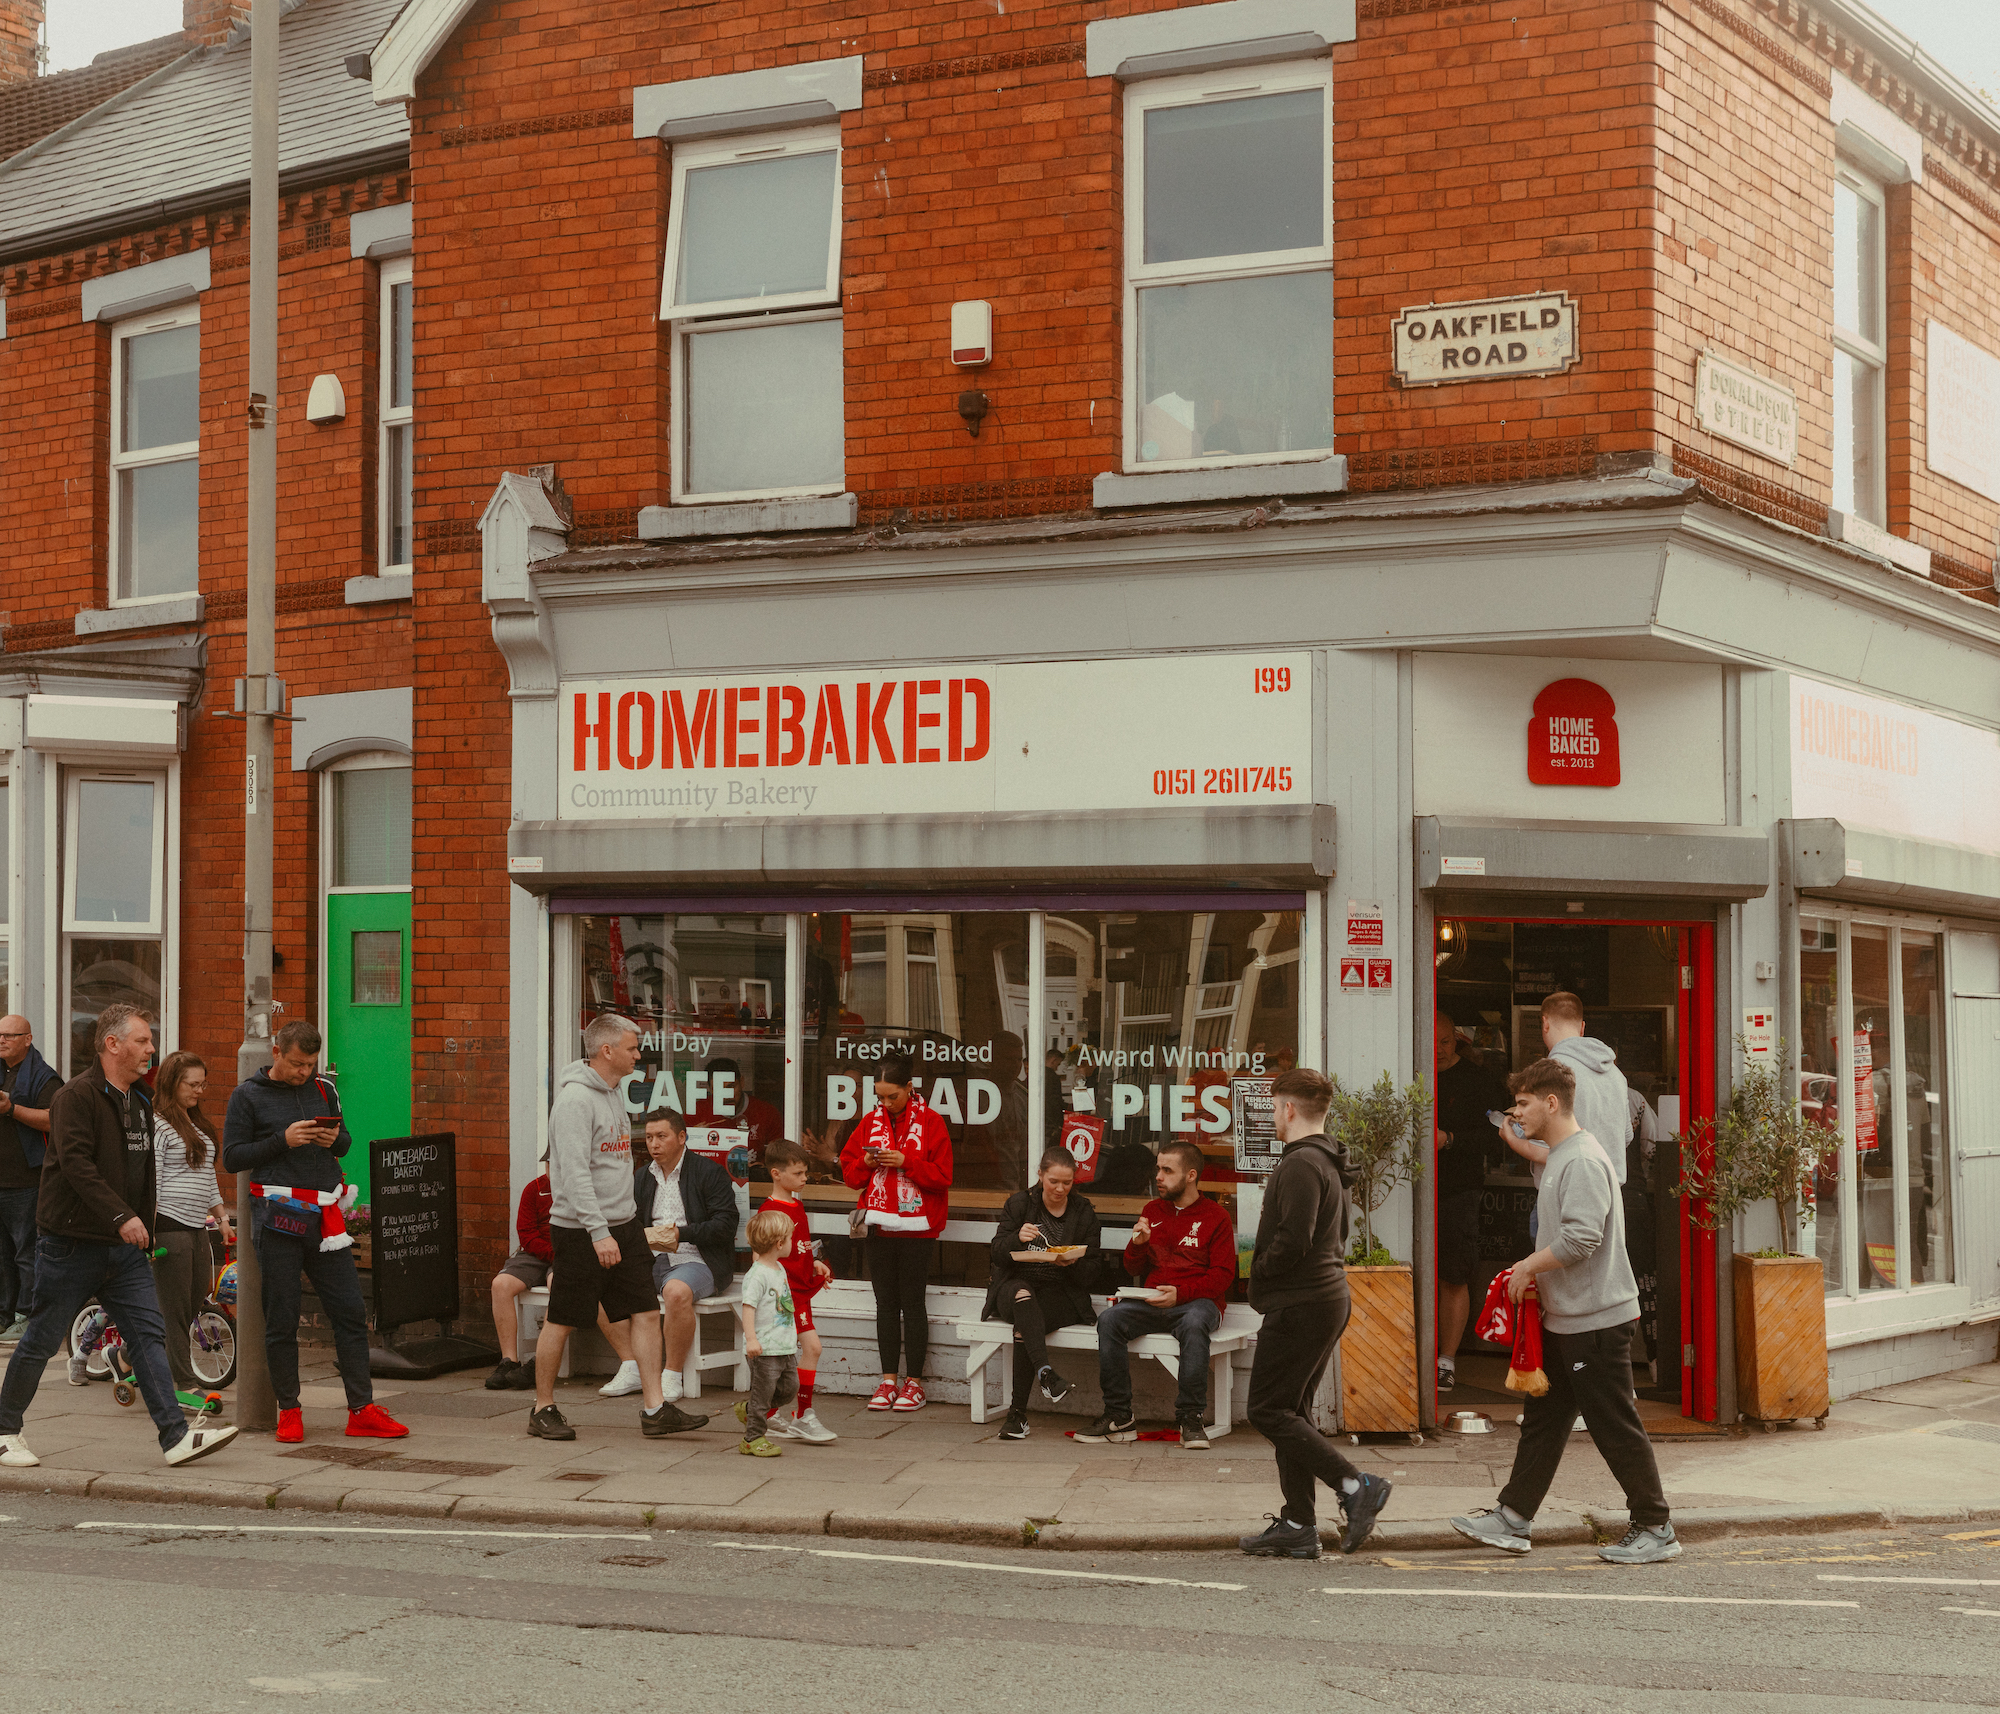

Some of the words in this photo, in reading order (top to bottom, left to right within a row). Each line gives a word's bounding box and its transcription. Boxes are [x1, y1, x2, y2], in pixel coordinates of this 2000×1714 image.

[1407, 308, 1561, 341] OAKFIELD
[1442, 342, 1528, 370] ROAD
[1710, 368, 1790, 425] DONALDSON
[1714, 400, 1787, 450] STREET
[1254, 667, 1291, 694] 199
[573, 677, 991, 772] HOMEBAKED
[1549, 716, 1594, 736] HOME
[1800, 693, 1919, 778] HOMEBAKED
[1549, 735, 1600, 755] BAKED
[1550, 758, 1569, 768] est.
[1570, 757, 1595, 769] 2013
[1152, 769, 1195, 795] 0151
[1203, 766, 1293, 794] 2611745
[571, 780, 719, 812] Community
[726, 778, 818, 811] Bakery
[1349, 911, 1381, 919] verisure
[1349, 921, 1382, 930] Alarm
[640, 1031, 666, 1052] All
[673, 1031, 712, 1058] Day
[922, 1039, 993, 1063] Baked
[1077, 1044, 1155, 1067] Award
[1161, 1045, 1267, 1076] Winning
[620, 1069, 736, 1116] CAFE
[1112, 1083, 1233, 1134] PIES
[382, 1144, 438, 1168] HOMEBAKED
[393, 1164, 424, 1180] BAKERY
[273, 1215, 308, 1235] VANS
[382, 1216, 387, 1226] IF
[388, 1215, 398, 1225] YOU
[398, 1213, 416, 1224] WOULD
[417, 1211, 430, 1222] LIKE
[430, 1210, 438, 1220] TO
[382, 1227, 401, 1238] BECOME
[401, 1225, 407, 1235] A
[407, 1222, 432, 1233] MEMBER
[432, 1219, 440, 1230] OF
[1481, 1213, 1495, 1225] TO
[383, 1250, 398, 1261] THEN
[397, 1248, 408, 1260] ASK
[409, 1245, 420, 1257] FOR
[420, 1246, 425, 1257] A
[424, 1244, 440, 1255] FORM
[392, 1235, 405, 1246] OUR
[1178, 1235, 1199, 1248] AXA
